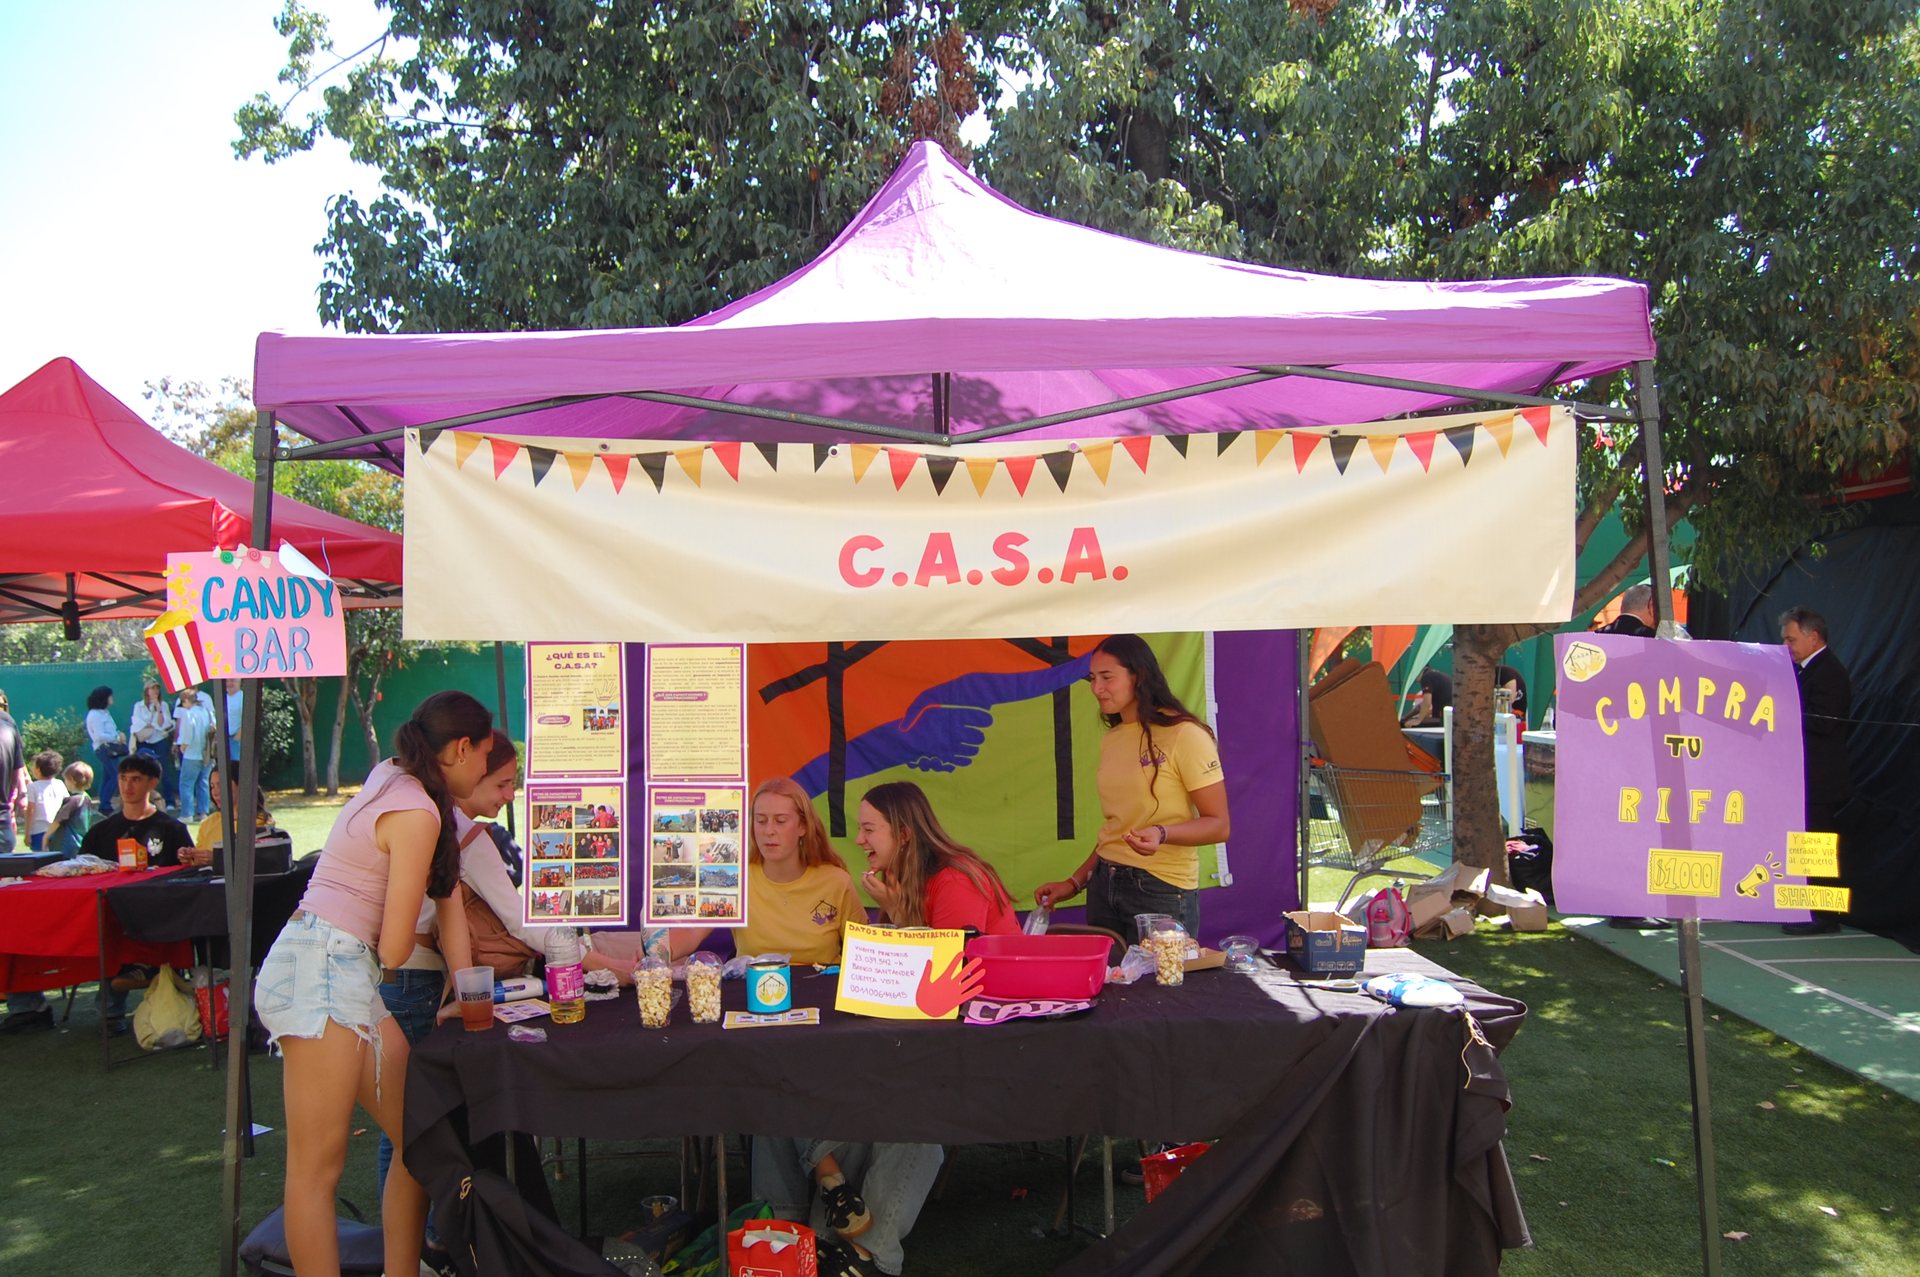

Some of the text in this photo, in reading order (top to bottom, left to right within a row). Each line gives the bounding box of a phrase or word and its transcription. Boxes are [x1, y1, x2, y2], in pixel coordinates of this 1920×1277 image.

[838, 526, 1129, 589] C.A.S.A.
[201, 576, 334, 623] CANDY
[234, 626, 314, 674] BAR
[546, 650, 574, 661] ¿QUÉ
[1595, 676, 1776, 736] COMPRA
[1664, 735, 1702, 759] TU
[1618, 788, 1744, 823] RIFA
[1792, 834, 1799, 844] Y
[1826, 837, 1832, 845] 2
[1777, 886, 1846, 909] SHAKIRA
[848, 924, 877, 936] DATOS
[897, 931, 960, 939] TRANSFERENCIA
[850, 974, 877, 983] CUENTA
[852, 963, 915, 977] BANCO SANTANDER
